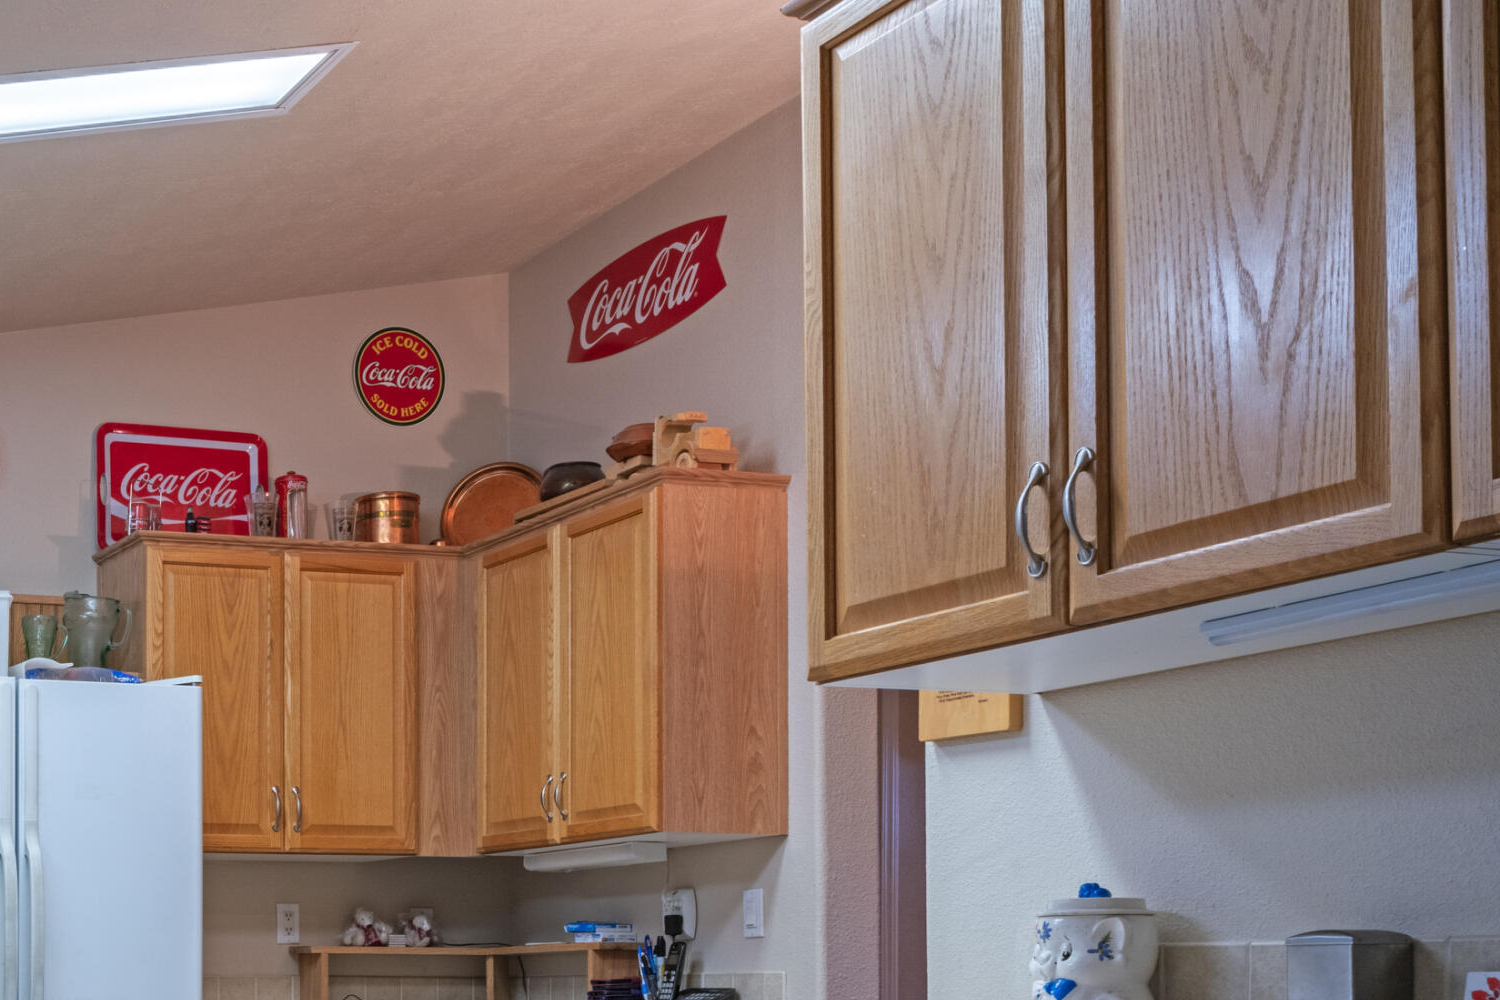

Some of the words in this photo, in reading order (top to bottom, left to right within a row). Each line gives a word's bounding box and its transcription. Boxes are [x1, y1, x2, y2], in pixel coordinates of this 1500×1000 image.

[580, 224, 709, 350] Coca-Cola
[371, 336, 393, 355] ICE
[395, 335, 429, 359] COLD
[362, 361, 437, 390] Coca-Cola
[371, 393, 398, 416] SOLD
[400, 397, 429, 417] HERE
[120, 462, 244, 509] Coca-Cola
